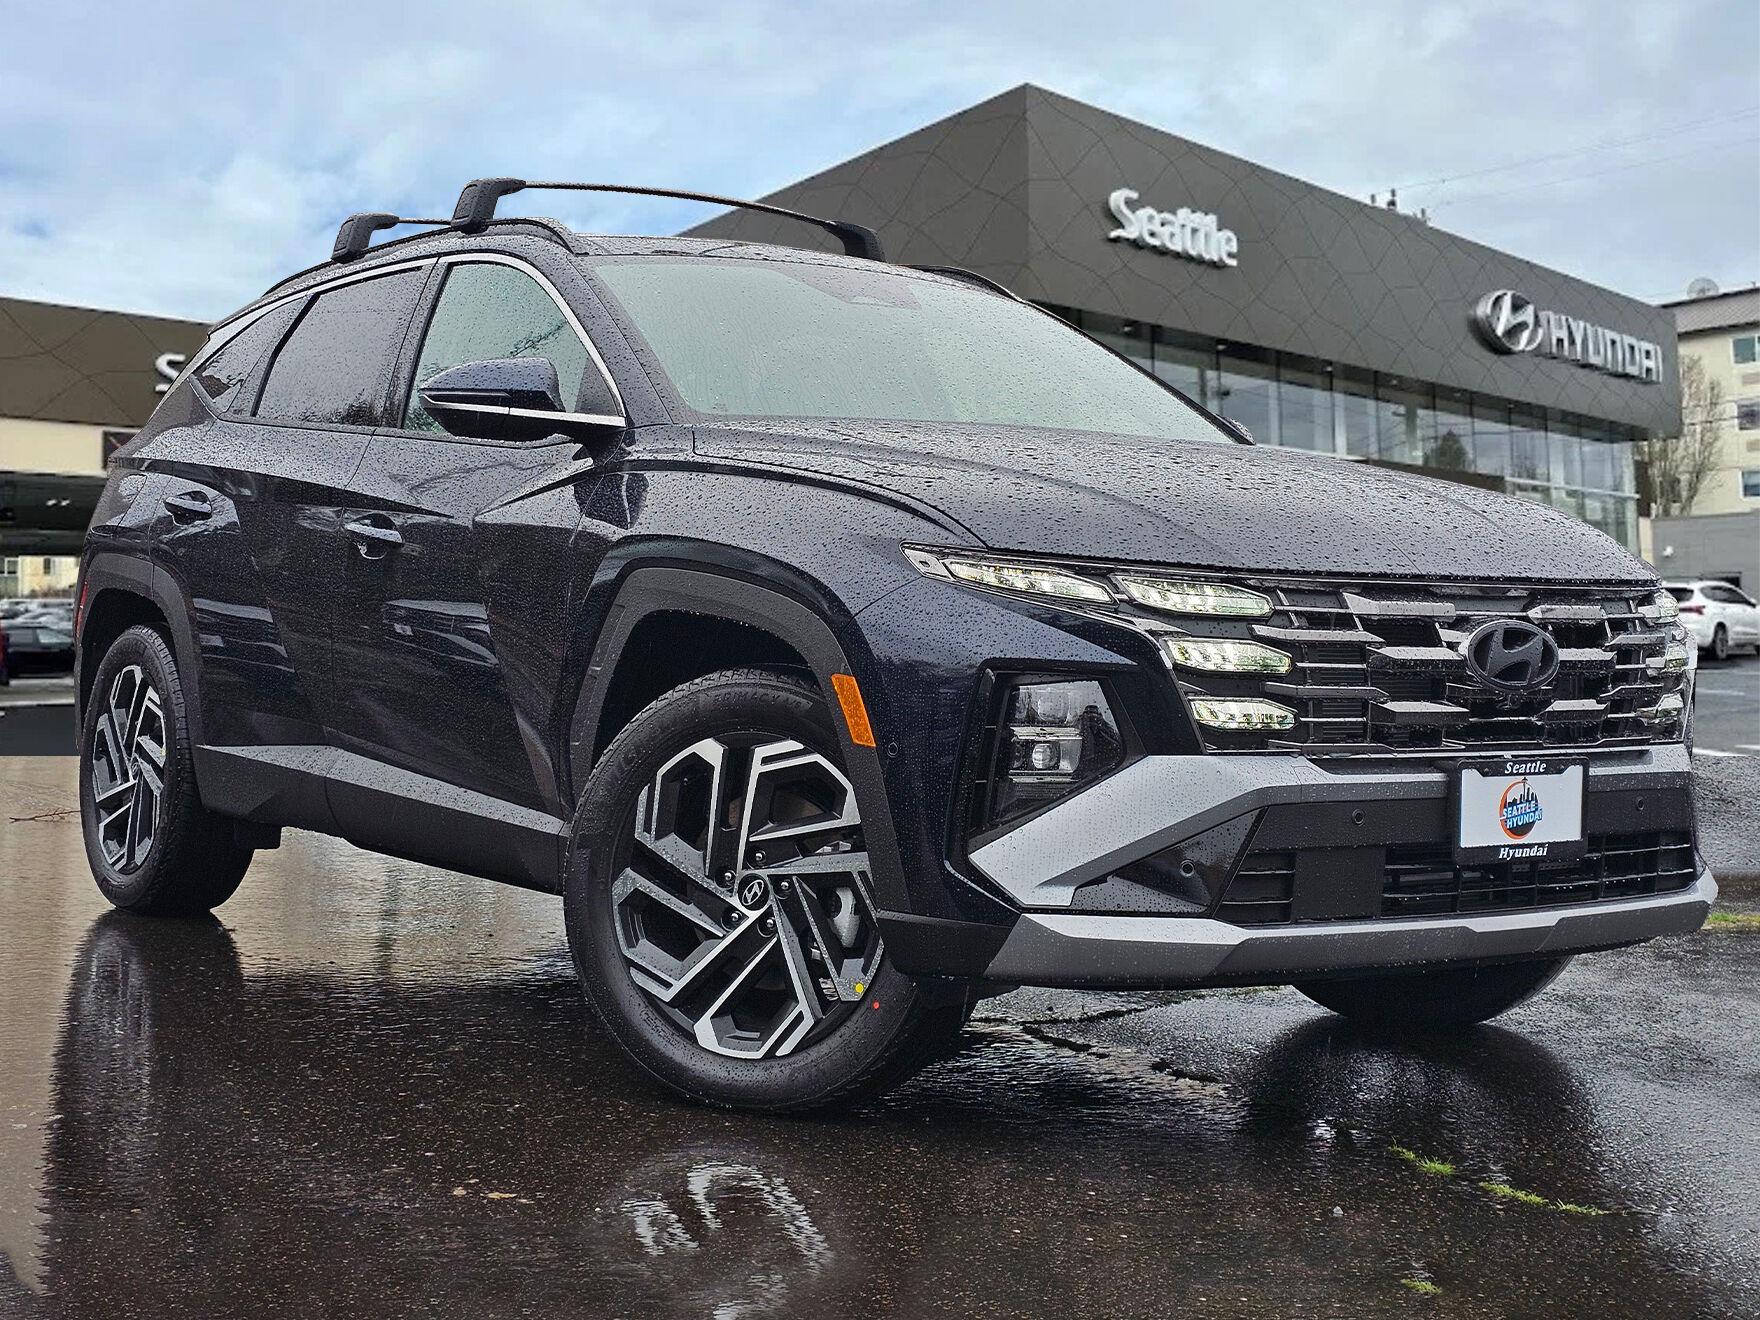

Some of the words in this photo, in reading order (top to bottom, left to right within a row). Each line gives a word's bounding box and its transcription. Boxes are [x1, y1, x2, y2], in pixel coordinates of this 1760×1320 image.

[1109, 188, 1238, 267] Seattle
[1539, 310, 1663, 383] HYUNDAI
[1504, 761, 1547, 774] Seattle
[1502, 801, 1538, 818] SEATTLE
[1506, 808, 1543, 829] HYUNDAI
[1499, 844, 1549, 860] Hyundai
